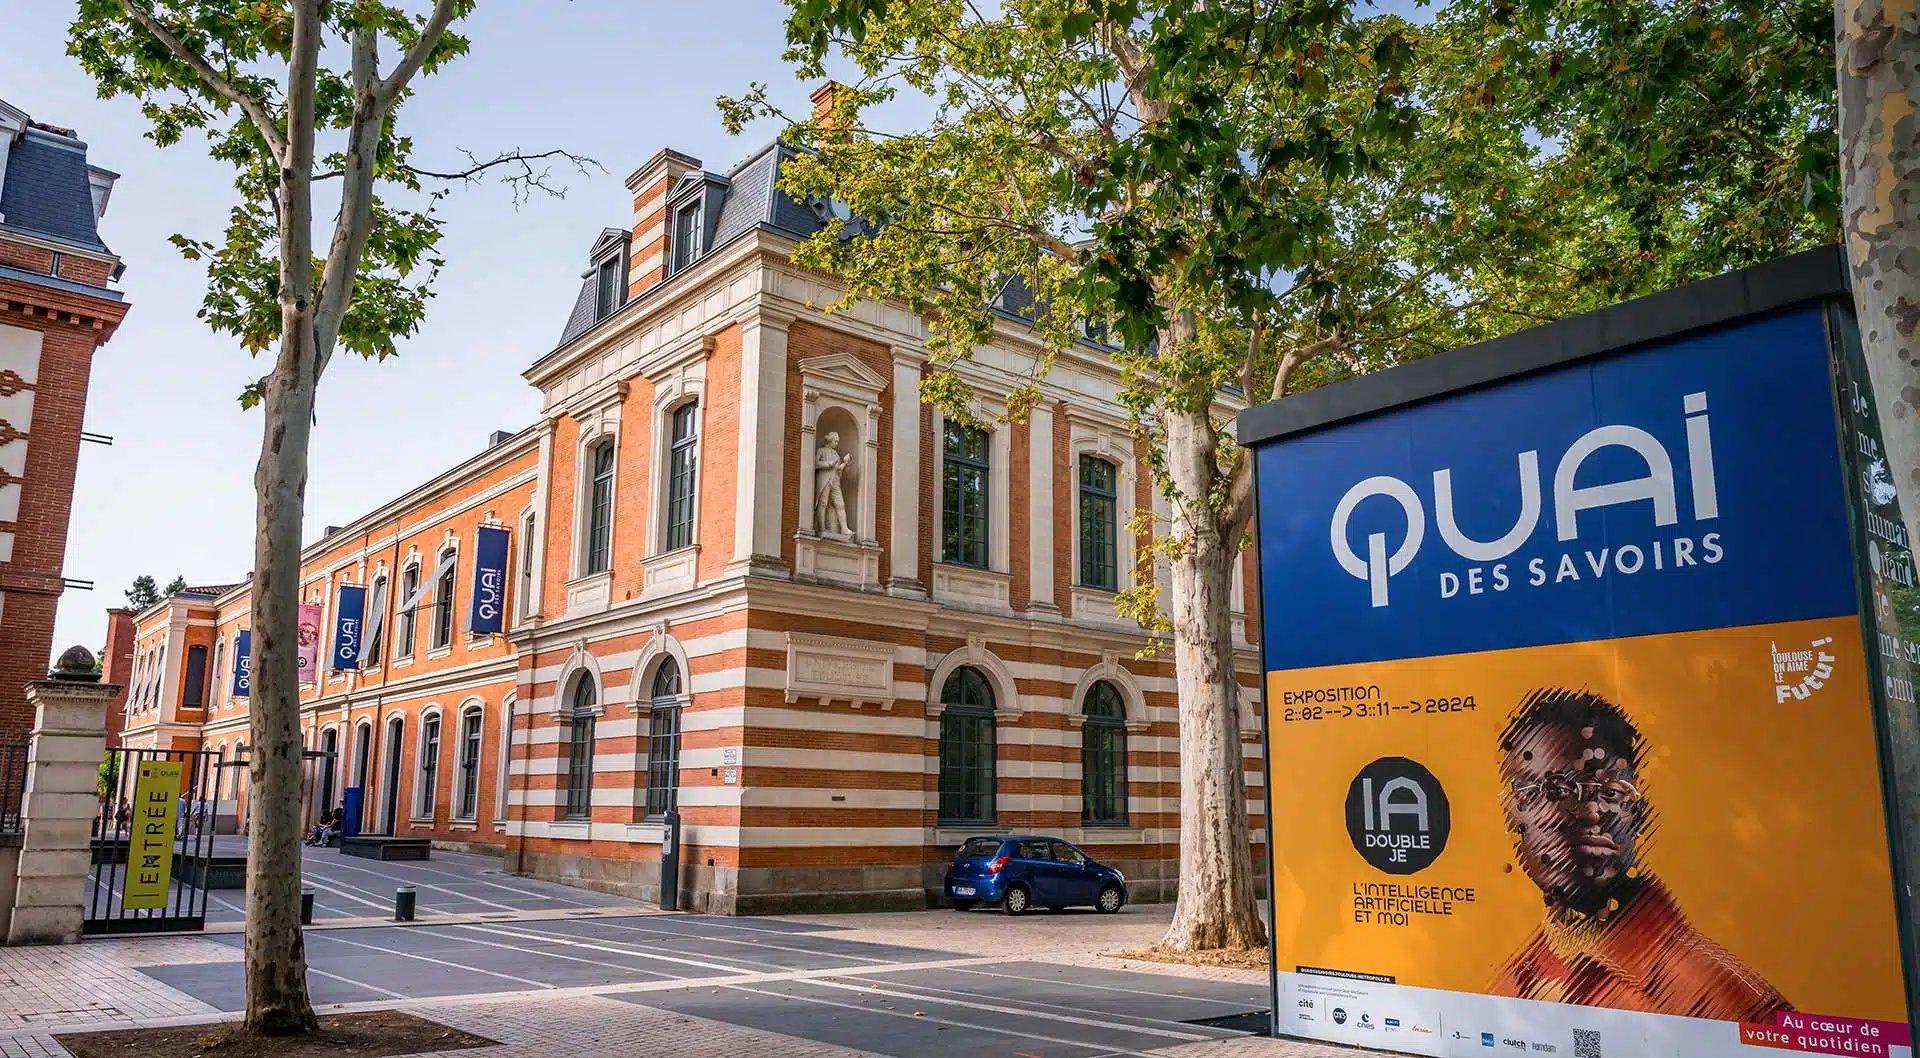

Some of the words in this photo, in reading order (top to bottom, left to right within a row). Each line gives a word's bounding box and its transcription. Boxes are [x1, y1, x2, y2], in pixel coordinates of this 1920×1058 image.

[1852, 381, 1868, 418] Je
[1857, 431, 1879, 461] me
[1440, 564, 1510, 598] DES
[1528, 532, 1724, 587] SAVOIRS
[1868, 539, 1914, 588] Quand
[1879, 632, 1900, 660] me
[1772, 650, 1813, 664] TOULOUSE
[1773, 661, 1785, 673] ON
[1787, 660, 1809, 672] AIME
[1774, 672, 1785, 683] LE
[1886, 663, 1916, 704] ému
[1425, 696, 1476, 713] 2024
[1363, 776, 1429, 832] IA
[1365, 834, 1431, 849] DOUBLE
[1389, 849, 1407, 863] JE
[1354, 896, 1453, 915] ARTIFICIELLE
[1355, 910, 1371, 923] ET
[1356, 1021, 1376, 1031] cnes
[1783, 1015, 1804, 1029] Au
[1810, 1020, 1852, 1034] cœur
[1860, 1024, 1880, 1037] de
[1503, 1038, 1526, 1049] clutch
[1746, 1030, 1790, 1044] votre
[1797, 1035, 1882, 1054] quotidien
